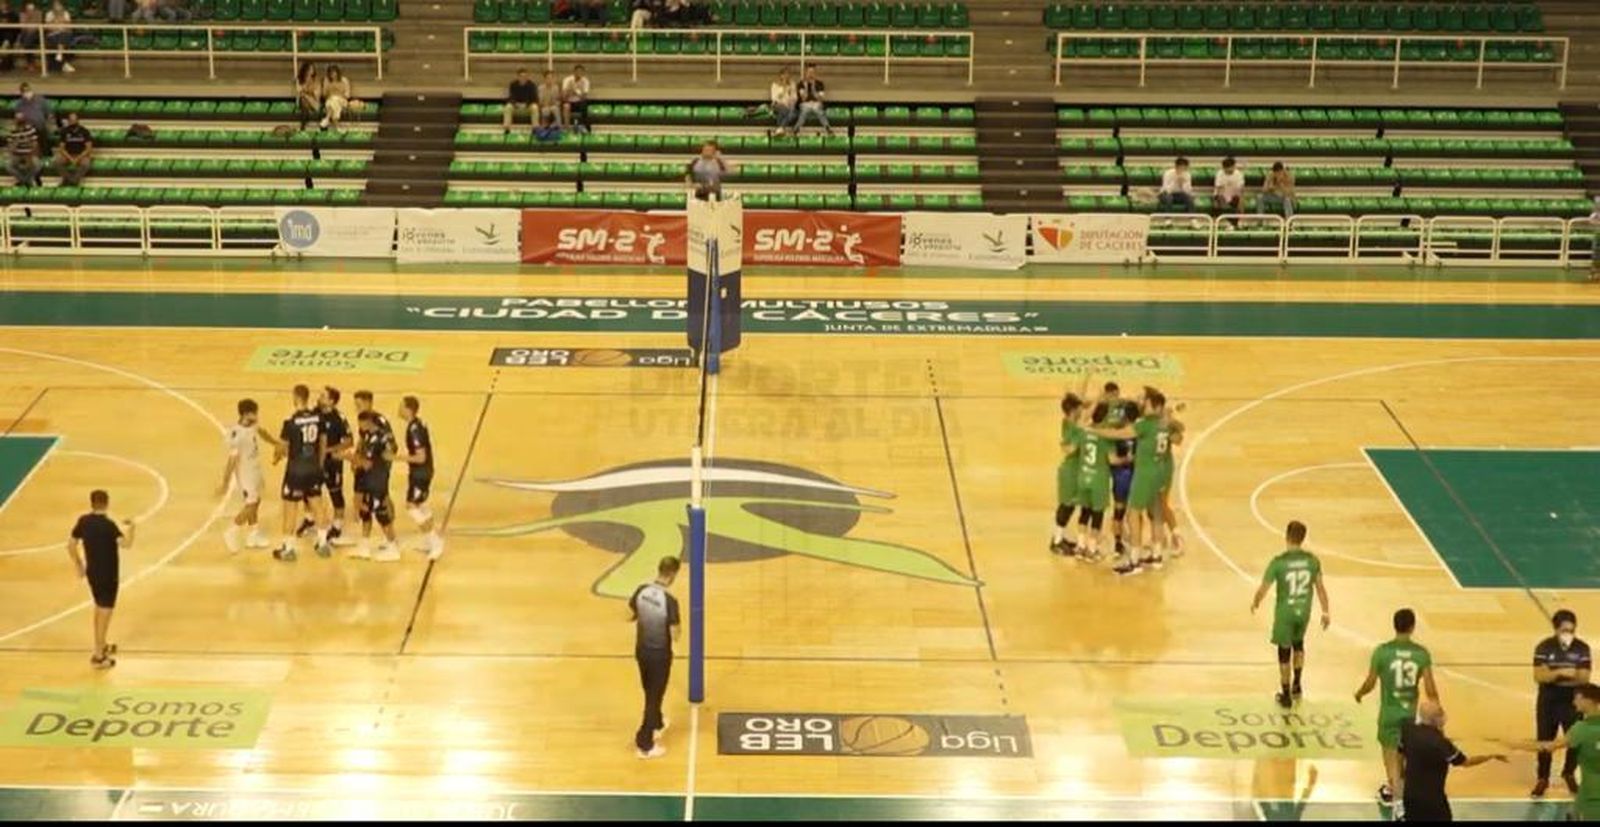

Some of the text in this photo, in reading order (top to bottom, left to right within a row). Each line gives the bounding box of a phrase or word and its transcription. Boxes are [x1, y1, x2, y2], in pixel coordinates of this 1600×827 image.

[557, 228, 637, 252] SM-2
[754, 228, 834, 252] SM-2
[651, 309, 688, 320] D
[824, 324, 1032, 333] JUNTA DE EXTREMADURA
[272, 348, 410, 362] Deporte
[1022, 355, 1160, 369] Deporte
[301, 424, 318, 443] 10
[1085, 442, 1097, 465] 3
[1285, 569, 1311, 597] 12
[1389, 659, 1418, 689] 13
[106, 696, 244, 716] Somos
[25, 712, 236, 743] Deporte
[745, 717, 833, 733] ORO
[1214, 708, 1354, 728] Somos
[739, 731, 1020, 754] Liga LEB
[1152, 724, 1364, 753] Deporte
